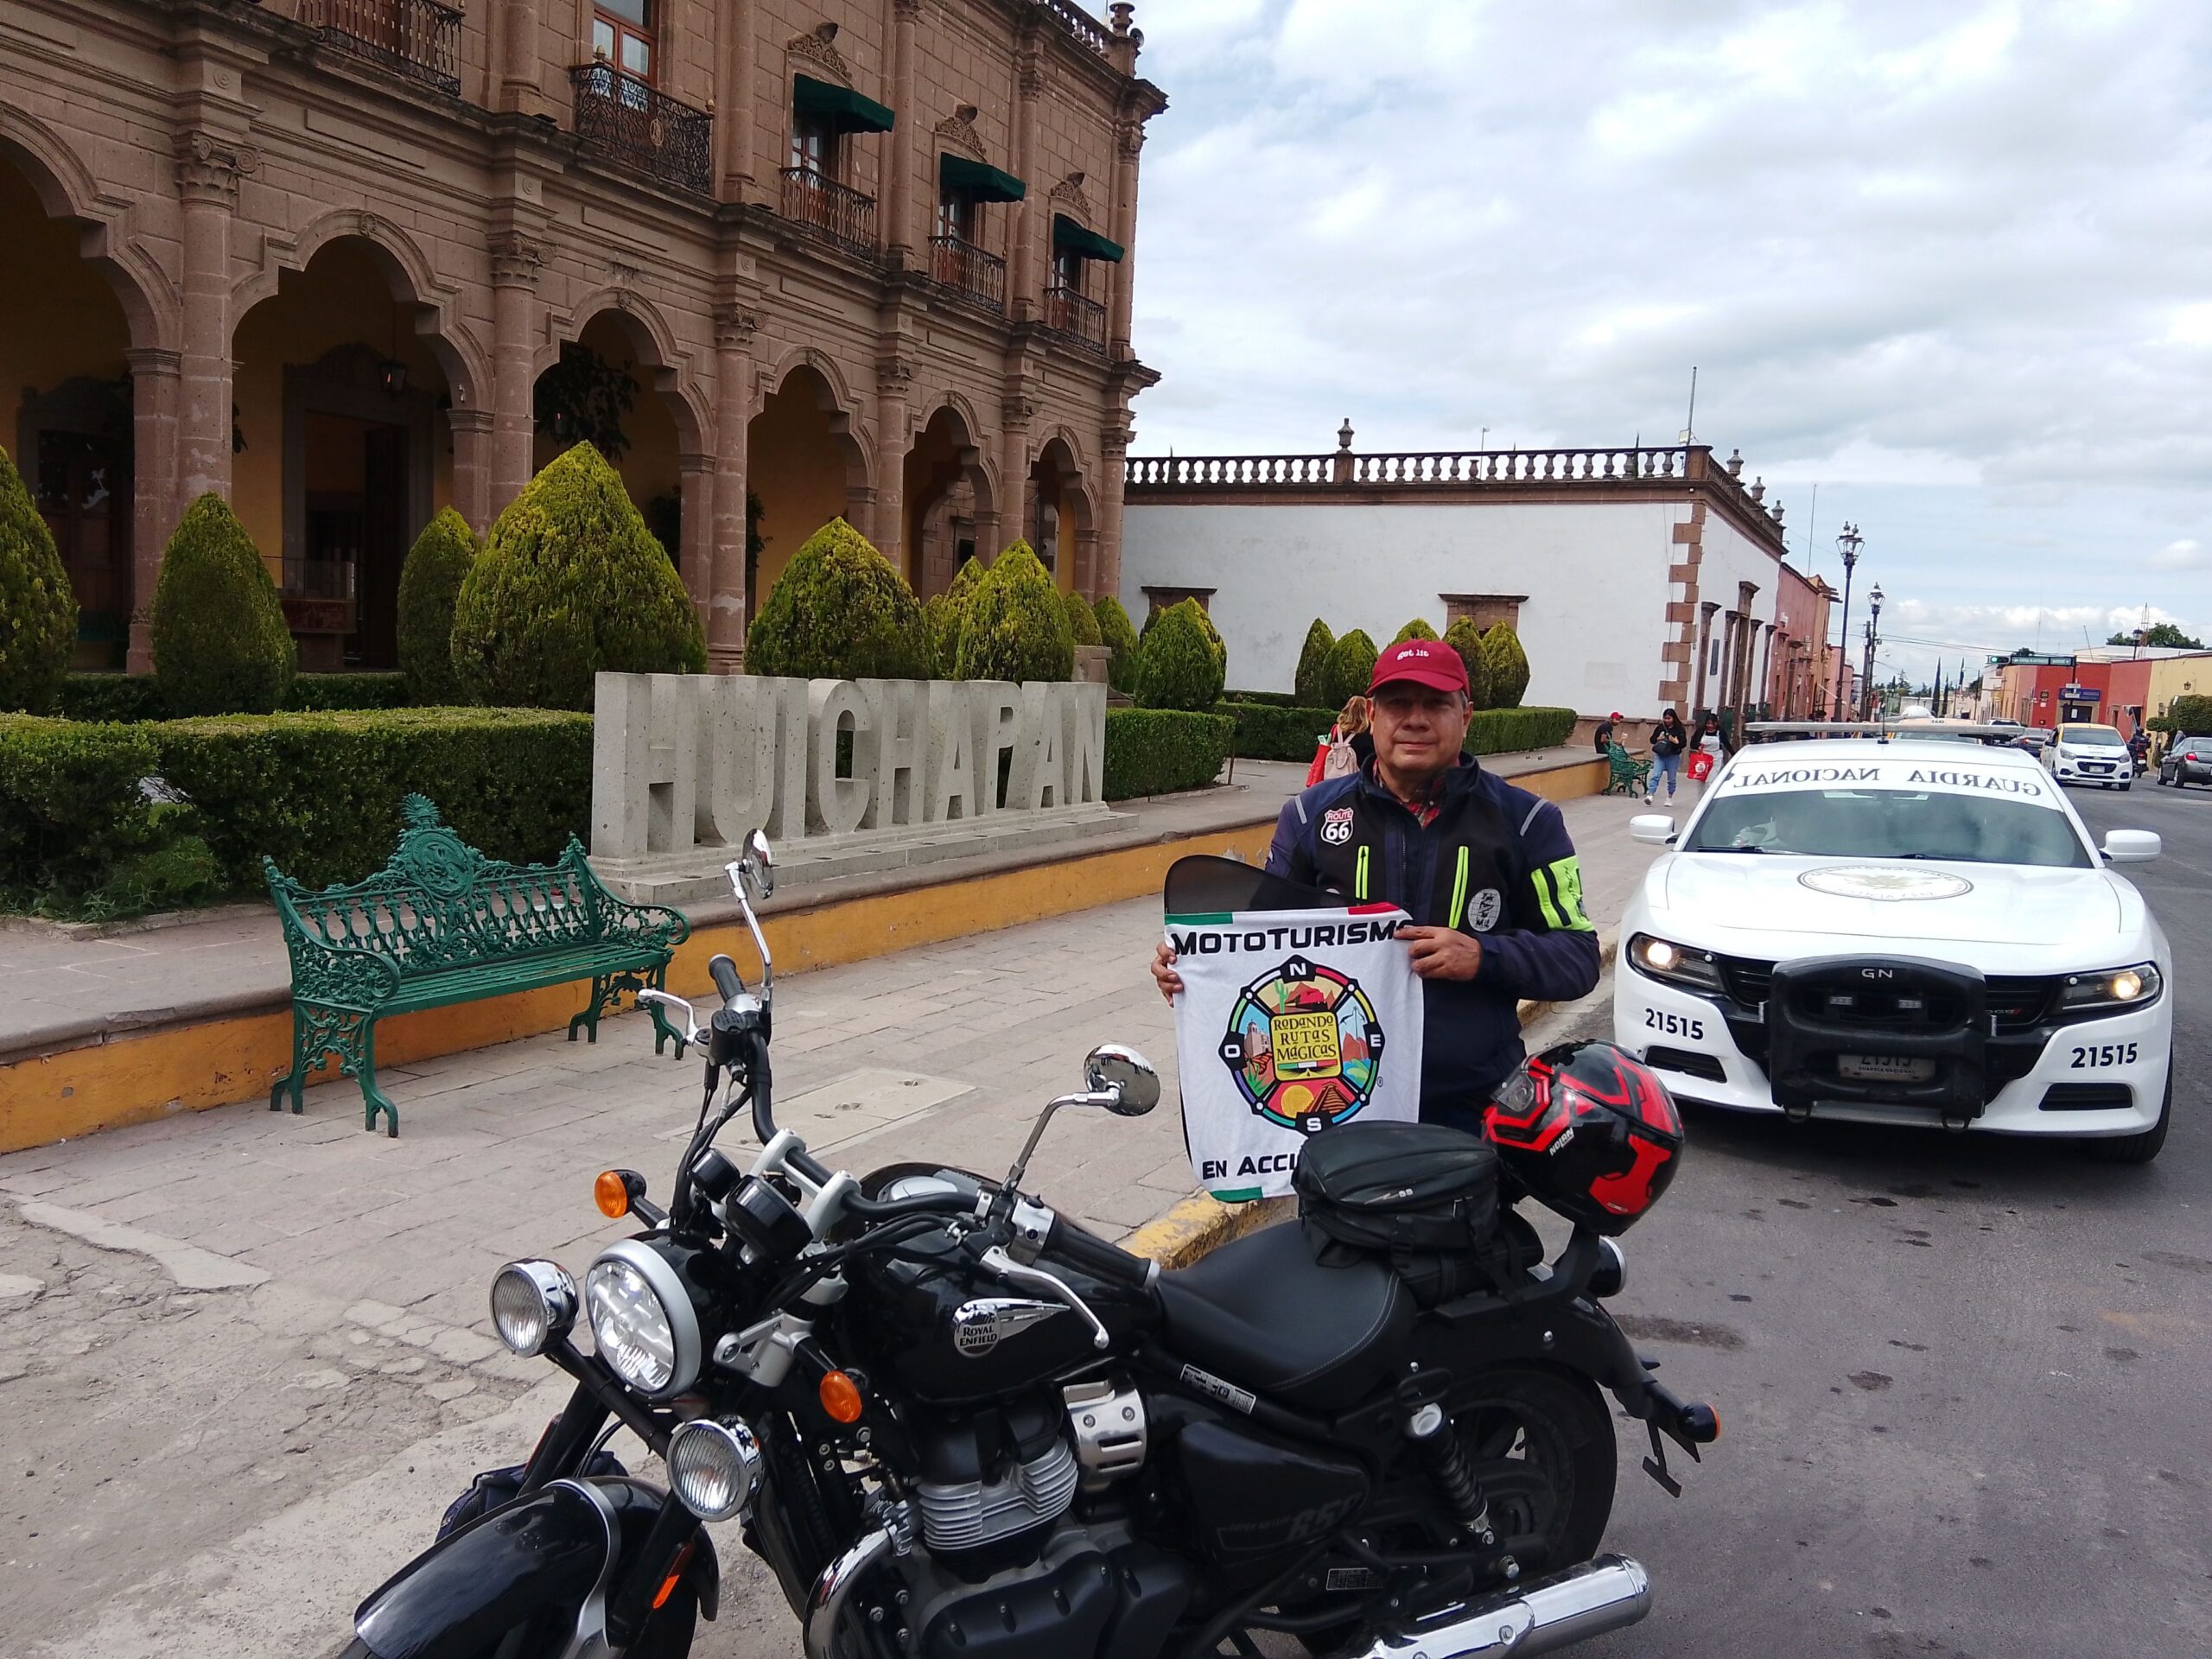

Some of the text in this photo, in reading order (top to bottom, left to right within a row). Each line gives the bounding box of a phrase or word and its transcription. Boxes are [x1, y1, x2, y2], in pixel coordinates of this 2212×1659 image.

[594, 671, 1106, 857] HUICHAPAN
[1327, 811, 1351, 820] ROUTE
[1325, 821, 1350, 840] 66
[1289, 963, 1306, 976] N
[1861, 968, 1893, 979] GN
[1644, 1007, 1704, 1040] 21515
[1370, 1033, 1382, 1047] E
[1224, 1044, 1241, 1058] O
[2070, 1042, 2138, 1068] 21515
[1306, 1117, 1322, 1132] S
[1548, 1127, 1575, 1156] NOLAN
[1202, 1154, 1296, 1180] EN ACCI
[963, 1325, 995, 1337] ROYAL
[959, 1333, 997, 1346] ENFIELD
